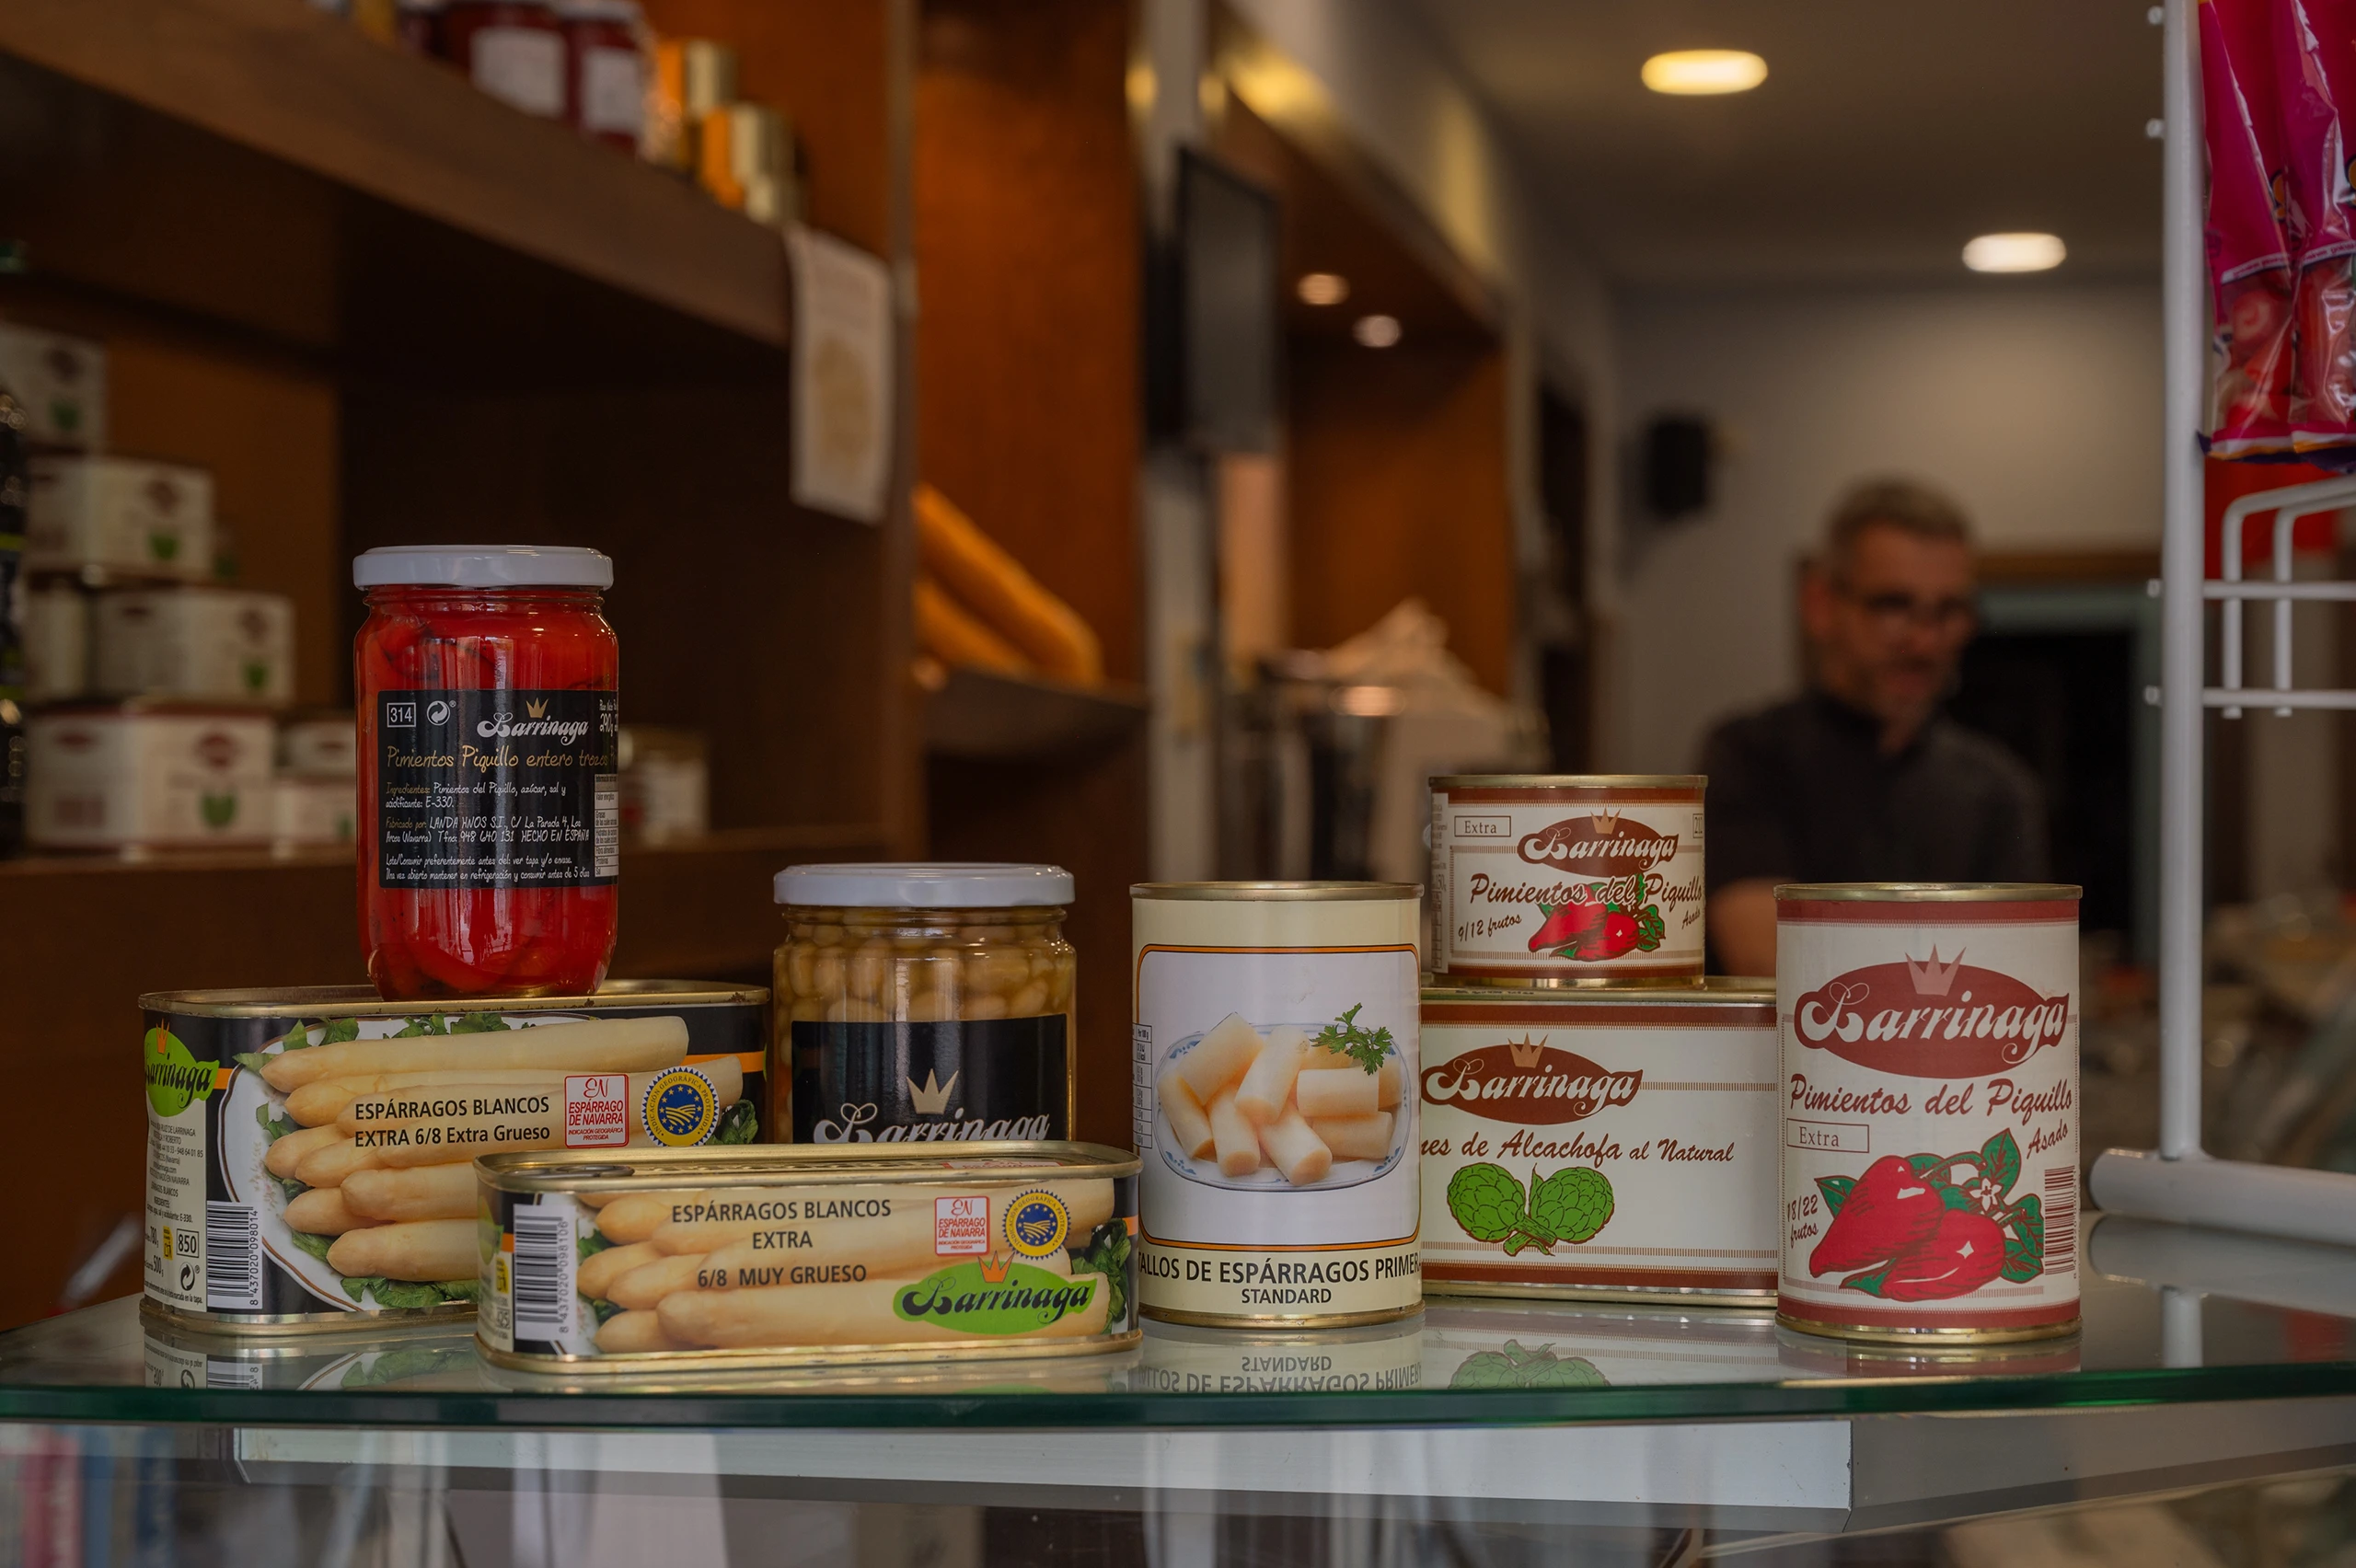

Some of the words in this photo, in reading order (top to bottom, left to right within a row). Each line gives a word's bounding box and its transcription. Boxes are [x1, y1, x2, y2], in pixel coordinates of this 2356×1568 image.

[390, 707, 412, 723] 314
[387, 745, 455, 768] Pimientos
[462, 744, 519, 773] Piquillo
[525, 749, 573, 768] entero
[579, 749, 607, 767] trozos
[387, 782, 430, 797] Ingredientes:
[433, 781, 469, 794] Pimientos
[472, 781, 486, 793] del
[549, 781, 559, 793] sal
[425, 796, 455, 808] E-330.
[429, 816, 458, 829] LANDA
[462, 816, 487, 828] HNOS
[510, 815, 522, 828] C/
[525, 816, 534, 828] La
[537, 816, 560, 828] Parada
[1464, 820, 1497, 834] Extra
[460, 830, 477, 842] 948
[479, 830, 497, 842] 640
[501, 830, 514, 842] 131
[521, 829, 549, 843] HECHO
[550, 829, 562, 842] EN
[478, 856, 496, 865] antes
[573, 866, 578, 878] 5
[1471, 872, 1587, 905] Pimientos
[1596, 875, 1637, 904] del
[1458, 919, 1484, 942] 9/12
[1488, 915, 1522, 937] frutos
[146, 1043, 213, 1109] arrinaga
[355, 1099, 468, 1120] ESPÁRRAGOS
[473, 1096, 549, 1115] BLANCOS
[569, 1099, 624, 1113] ESPÁRRAGO
[1790, 1073, 1912, 1114] Pimientos
[1925, 1084, 1975, 1116] del
[1987, 1078, 2072, 1125] Piquillo
[569, 1114, 582, 1126] DE
[583, 1113, 624, 1125] NAVARRA
[355, 1129, 410, 1147] EXTRA
[415, 1127, 442, 1146] 6/8
[447, 1127, 489, 1143] Extra
[493, 1124, 550, 1142] Grueso
[1799, 1126, 1840, 1147] Extra
[2027, 1119, 2068, 1159] Asado
[1461, 1131, 1489, 1157] de
[1496, 1129, 1623, 1169] Alcachofa
[1629, 1140, 1650, 1160] al
[1657, 1138, 1735, 1162] Natural
[672, 1200, 798, 1223] ESPÁRRAGOS
[804, 1199, 891, 1219] BLANCOS
[1787, 1194, 1818, 1222] 18/22
[249, 1210, 259, 1250] 098014
[939, 1216, 986, 1228] ESPÁRRAGO
[939, 1228, 950, 1238] DE
[950, 1228, 986, 1238] NAVARRA
[178, 1234, 196, 1253] 850
[753, 1230, 814, 1250] EXTRA
[1790, 1223, 1819, 1249] frutos
[249, 1254, 259, 1294] 437020
[698, 1269, 727, 1287] 6/8
[739, 1267, 784, 1286] MUY
[790, 1264, 867, 1285] GRUESO
[1186, 1260, 1212, 1282] DE
[1219, 1258, 1369, 1284] ESPÁRRAGOS
[1242, 1288, 1332, 1304] STANDARD
